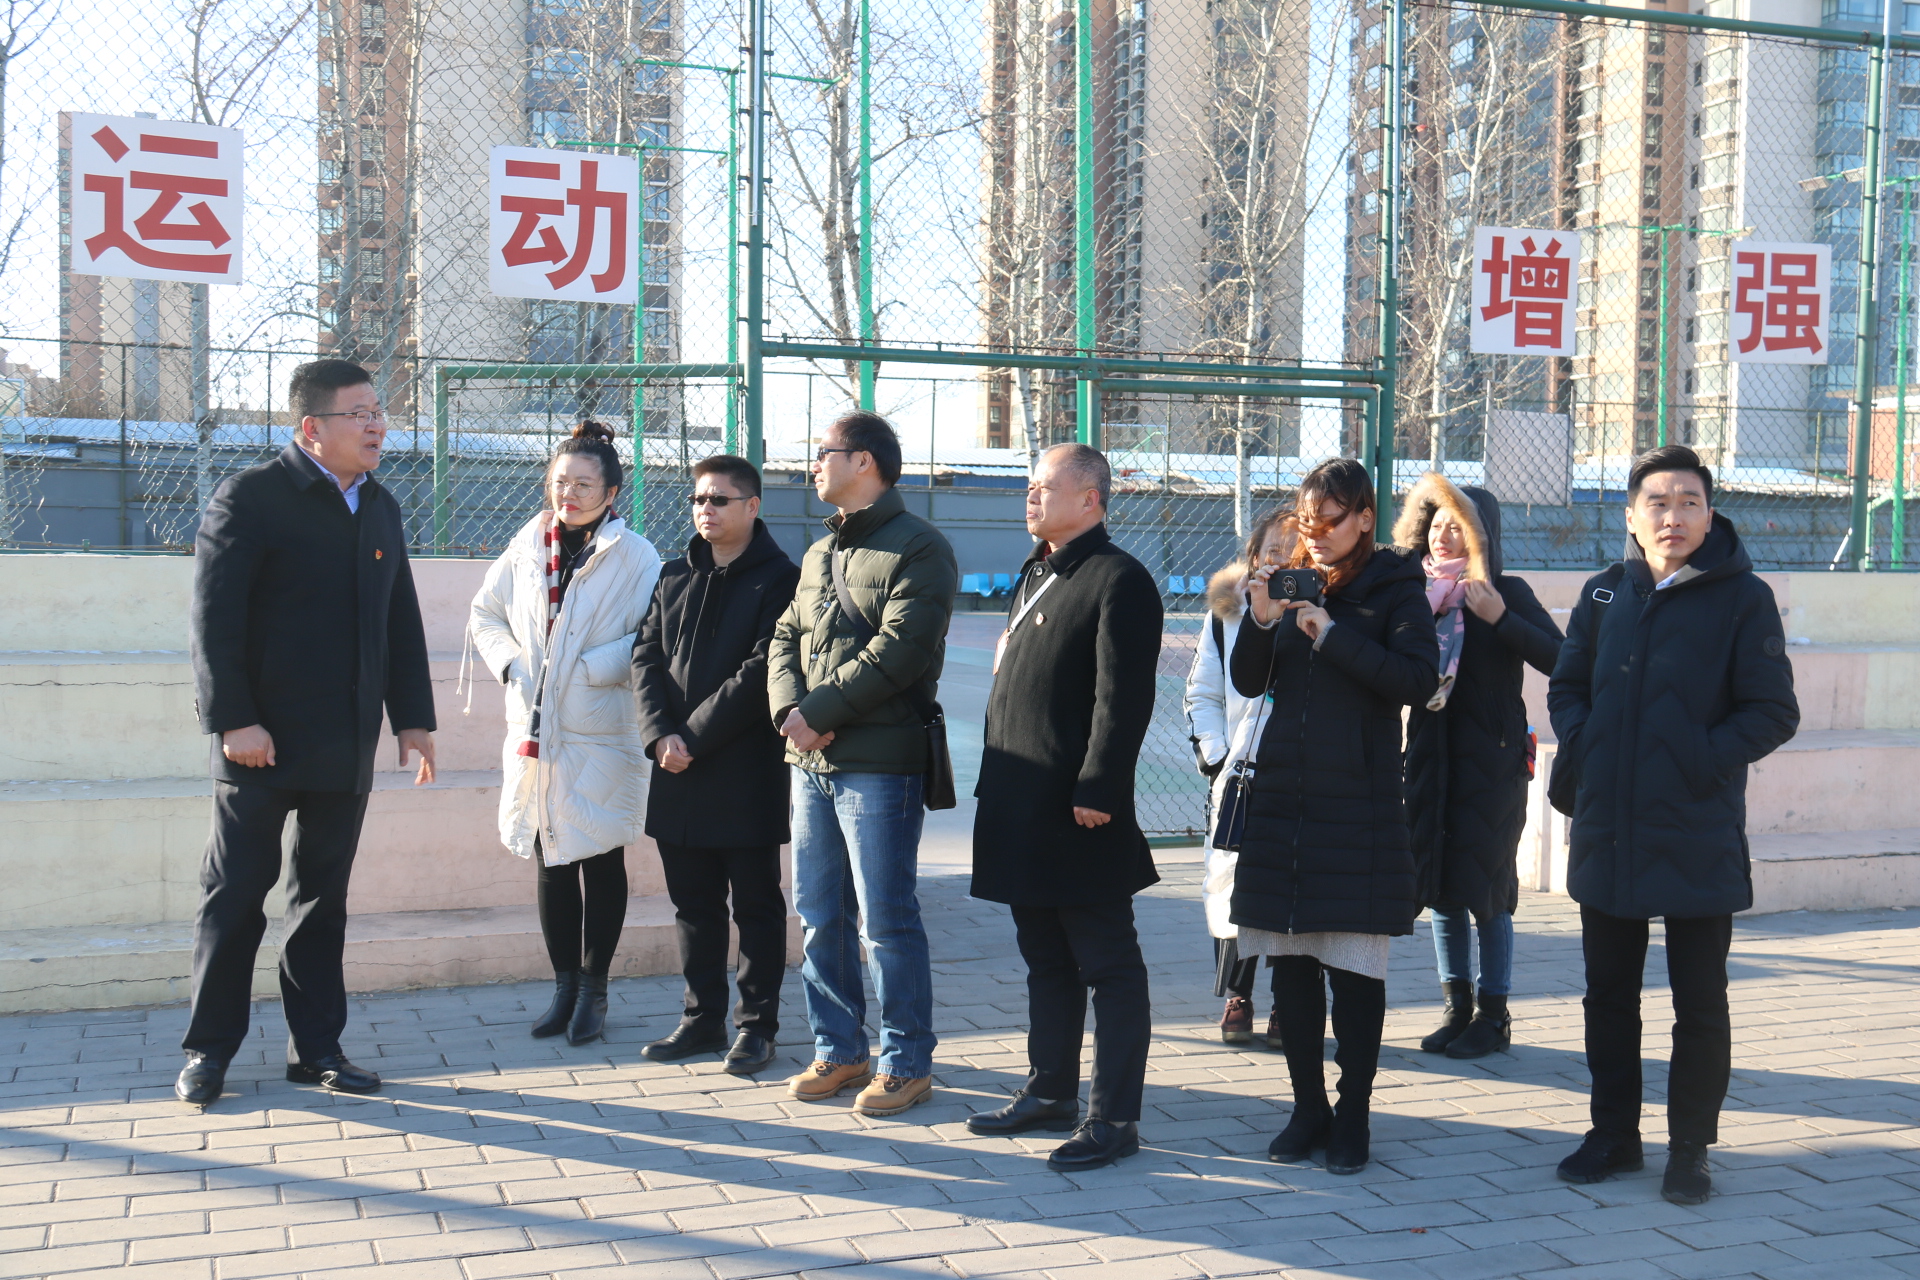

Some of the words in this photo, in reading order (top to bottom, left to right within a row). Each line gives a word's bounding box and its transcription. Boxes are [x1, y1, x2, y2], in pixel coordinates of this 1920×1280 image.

[84, 126, 230, 274] 运
[501, 160, 627, 293] 动
[1481, 236, 1570, 349] 增
[1737, 252, 1822, 354] 强
